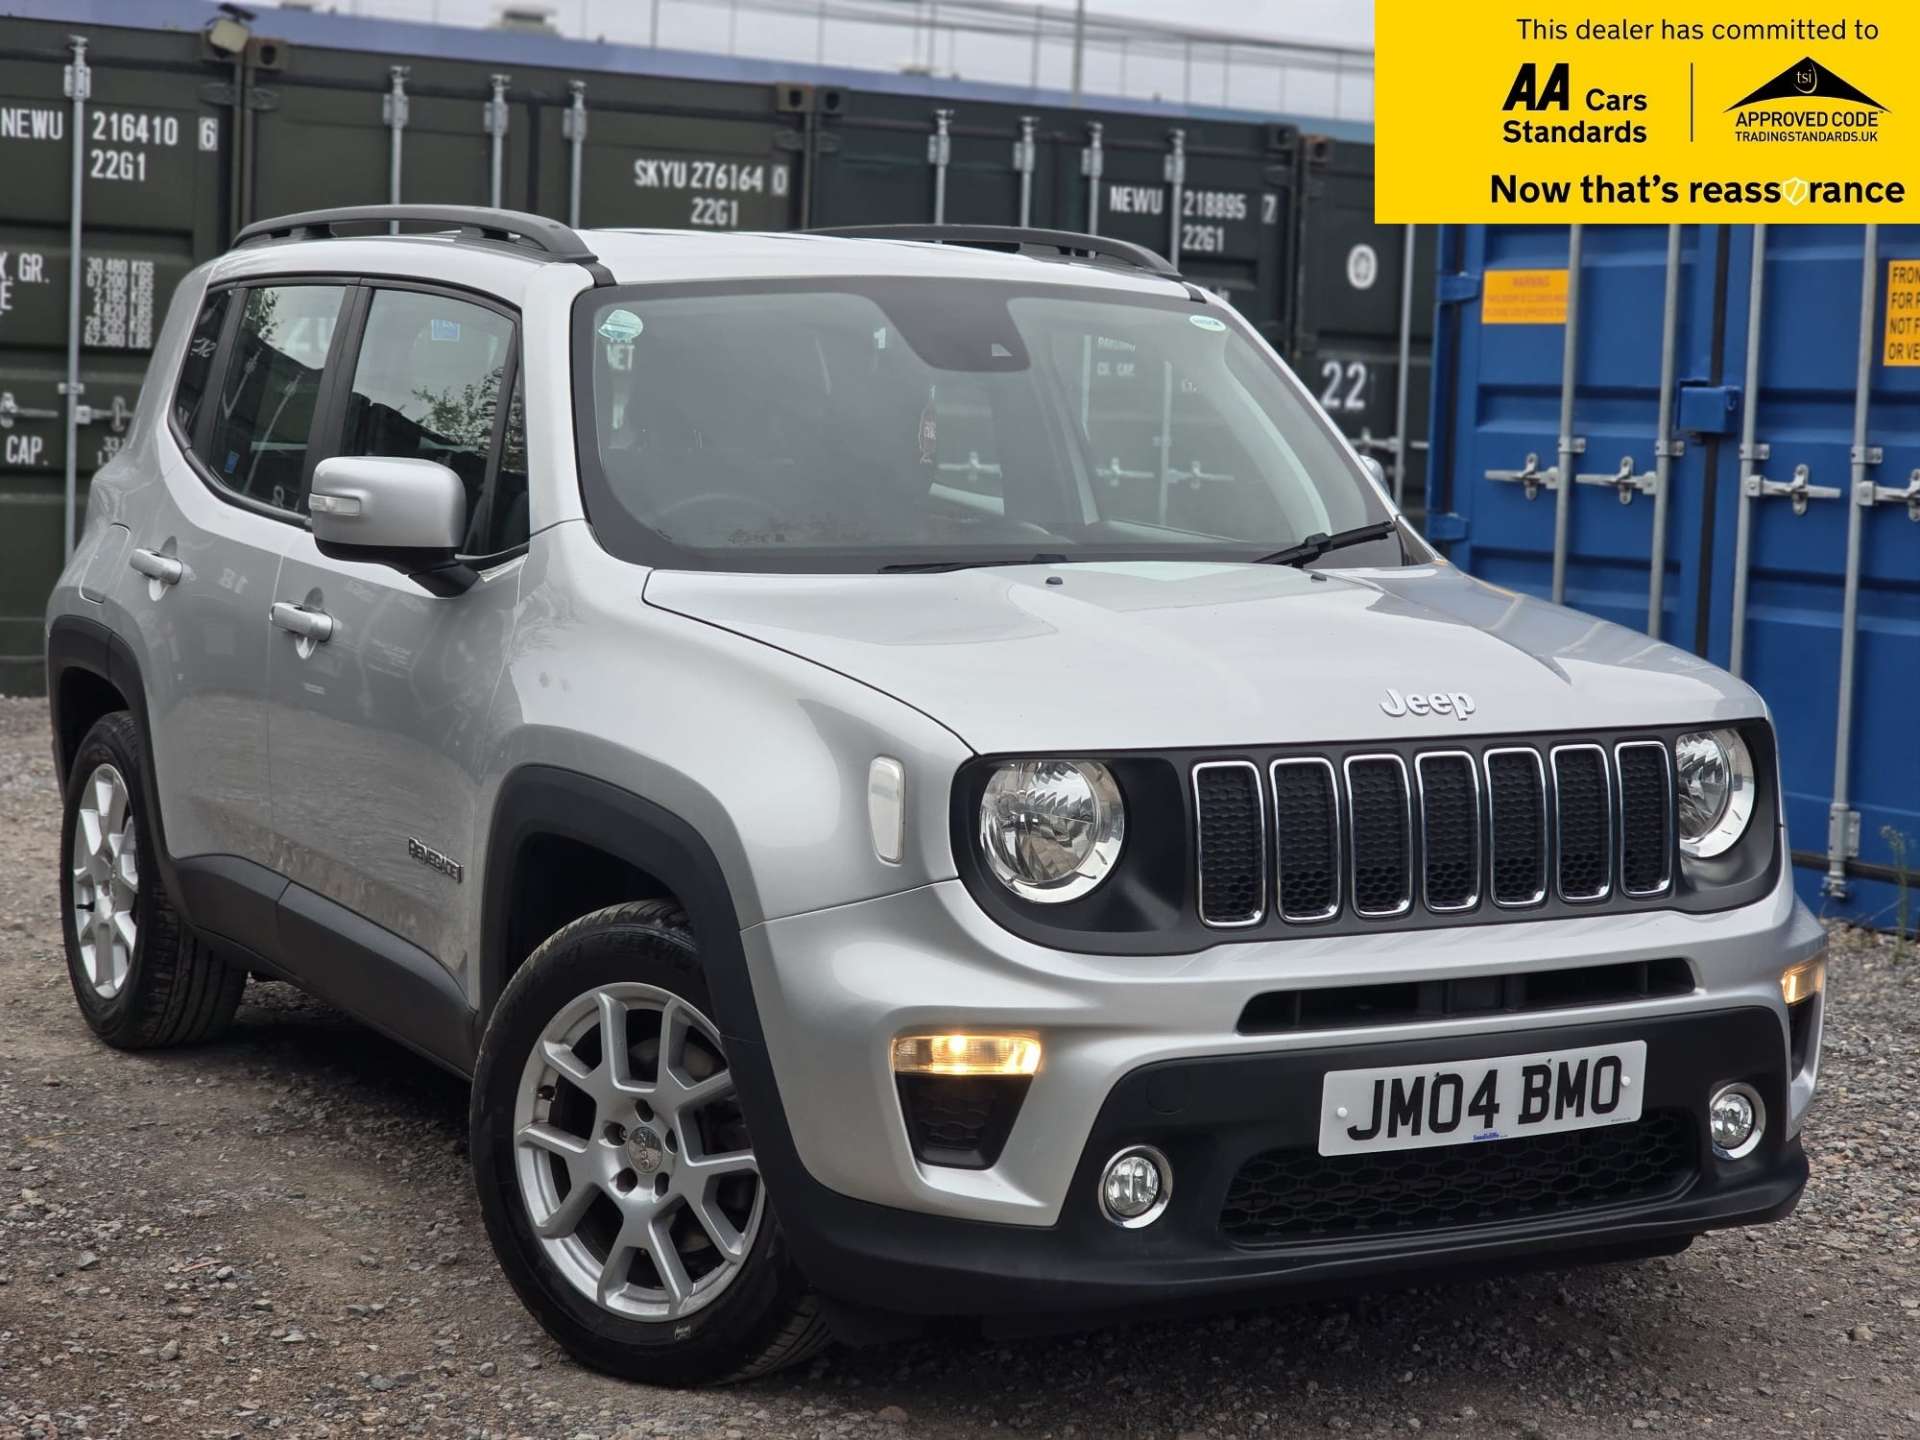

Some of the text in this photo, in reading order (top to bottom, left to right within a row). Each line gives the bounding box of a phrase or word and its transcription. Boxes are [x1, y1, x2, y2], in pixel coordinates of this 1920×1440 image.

[0, 108, 217, 150] NEWU 216410 6
[90, 149, 146, 181] 22G1
[634, 158, 687, 189] SKYU
[690, 161, 764, 194] 276164
[690, 197, 739, 228] 22G1
[1109, 185, 1164, 214] NEWU
[1182, 190, 1247, 220] 218895
[1181, 224, 1225, 252] 22G1
[18, 252, 50, 284] GR.
[1321, 359, 1367, 411] 22
[6, 435, 48, 466] CAP.
[1379, 688, 1476, 721] Jeep
[1347, 1055, 1623, 1141] JM04 BMO
